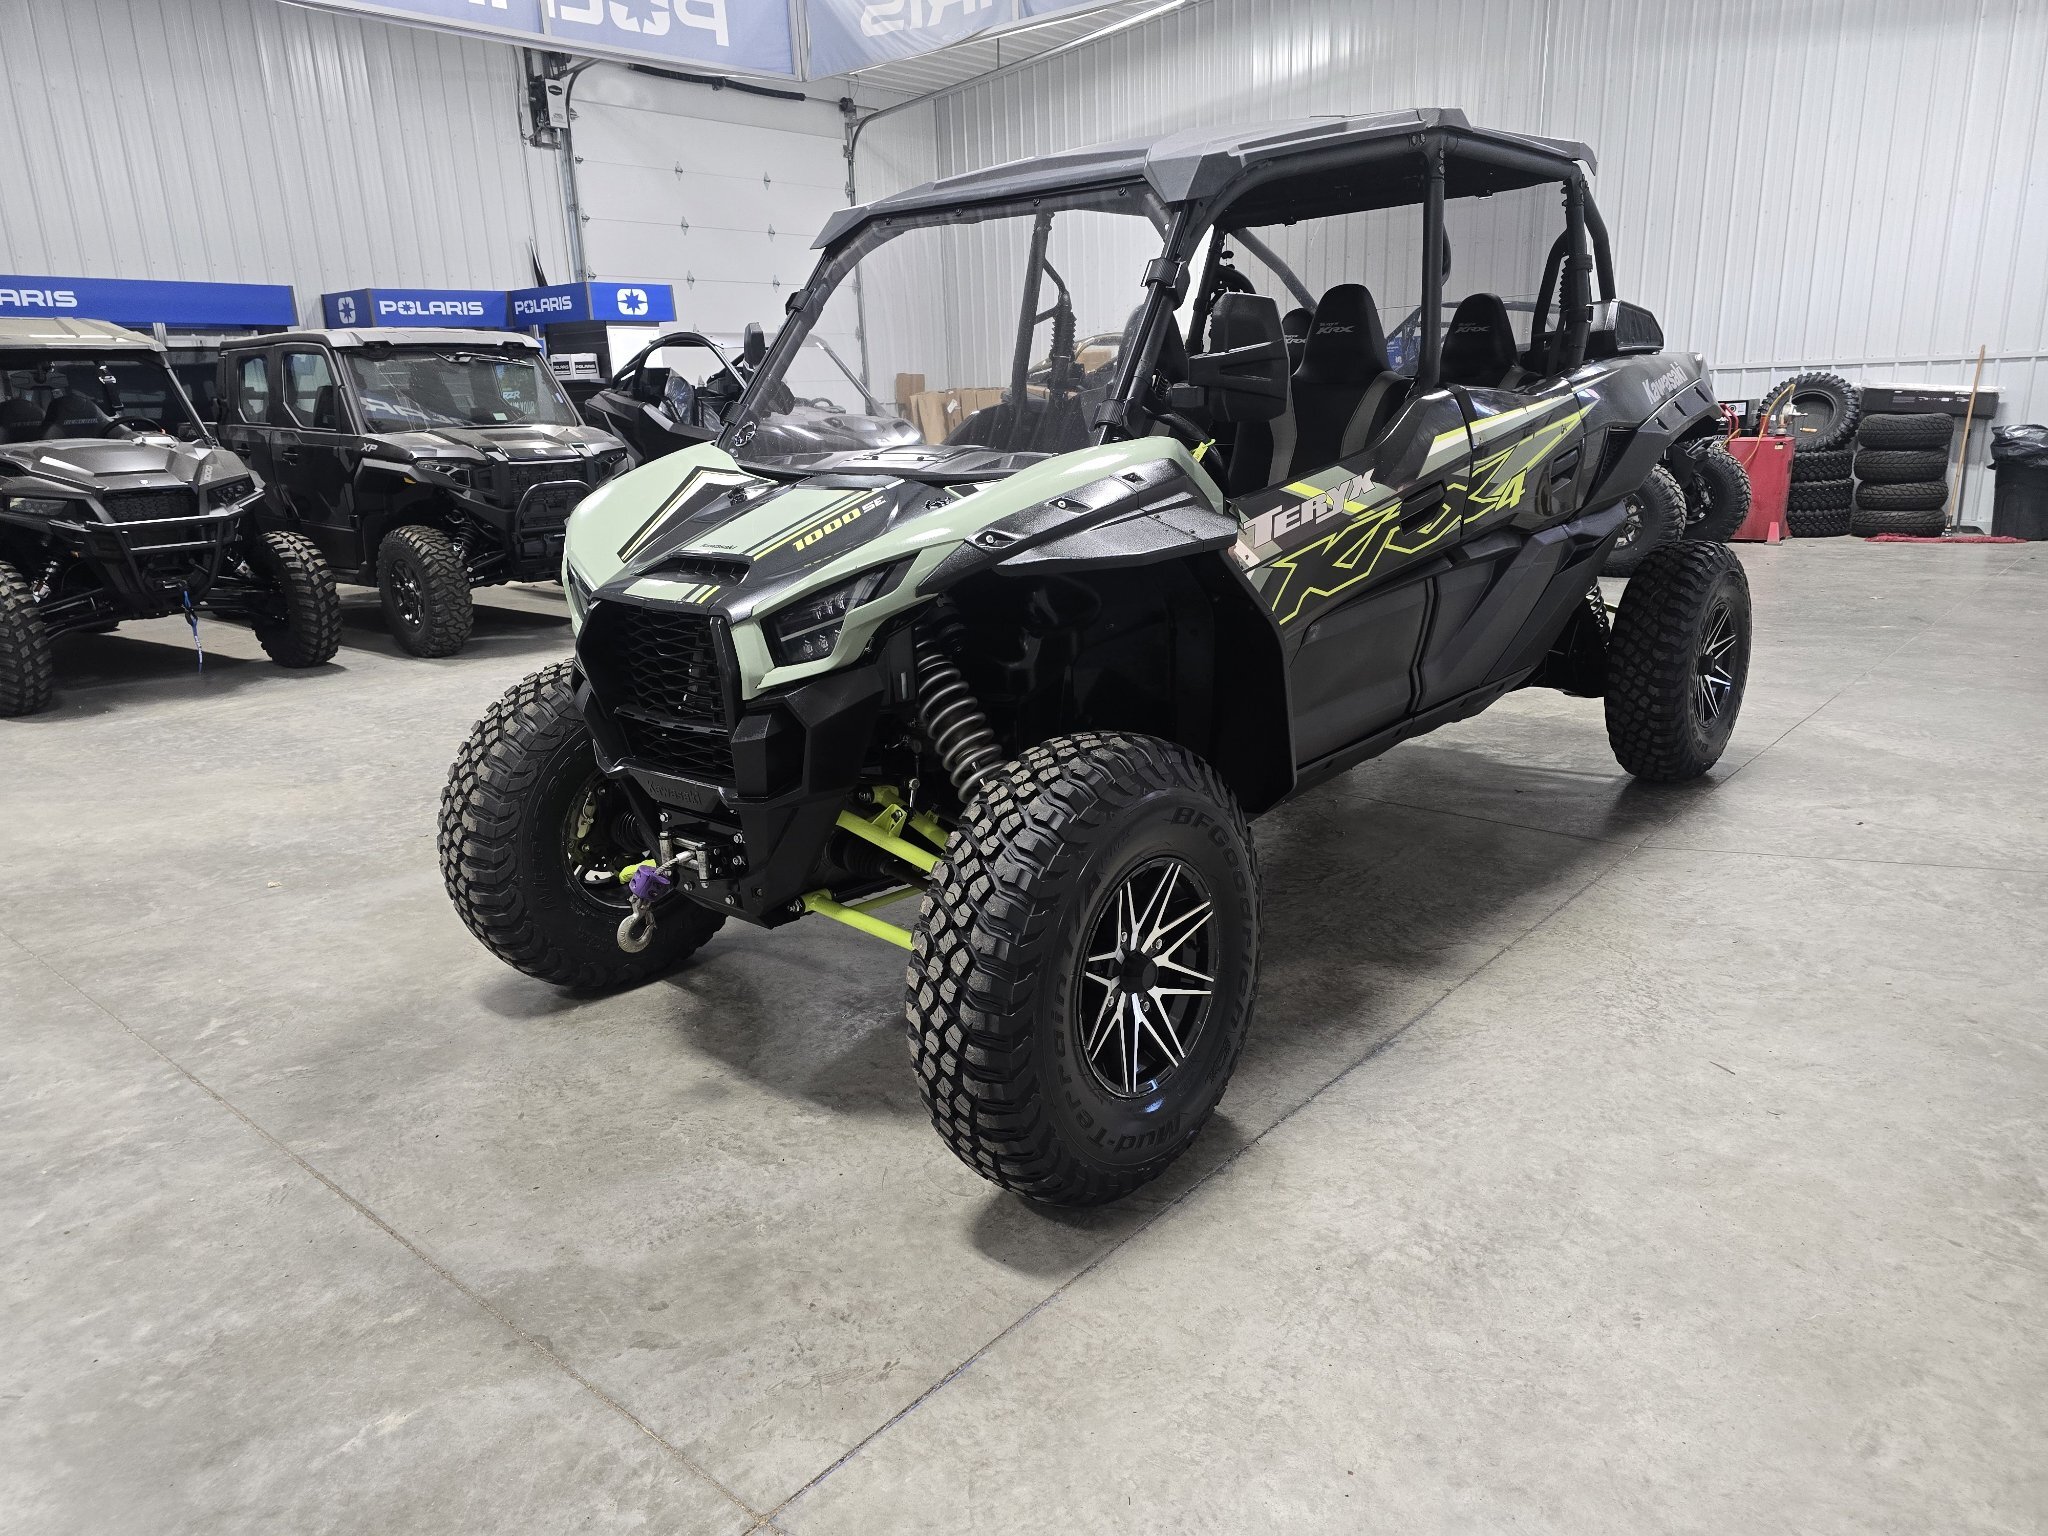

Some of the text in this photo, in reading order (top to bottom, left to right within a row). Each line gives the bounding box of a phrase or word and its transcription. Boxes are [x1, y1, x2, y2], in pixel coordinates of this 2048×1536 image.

[379, 300, 484, 316] POLARIS
[515, 295, 572, 315] POLARIS
[1315, 325, 1355, 335] KRX
[502, 390, 521, 399] RZR
[1642, 361, 1689, 405] Kawasaki
[360, 442, 379, 453] XP
[1494, 467, 1528, 512] 4
[1242, 467, 1376, 549] TERYX
[792, 495, 886, 552] 1000 SE
[648, 780, 703, 805] Kawasaki
[1171, 806, 1254, 1029] BFGoodrich
